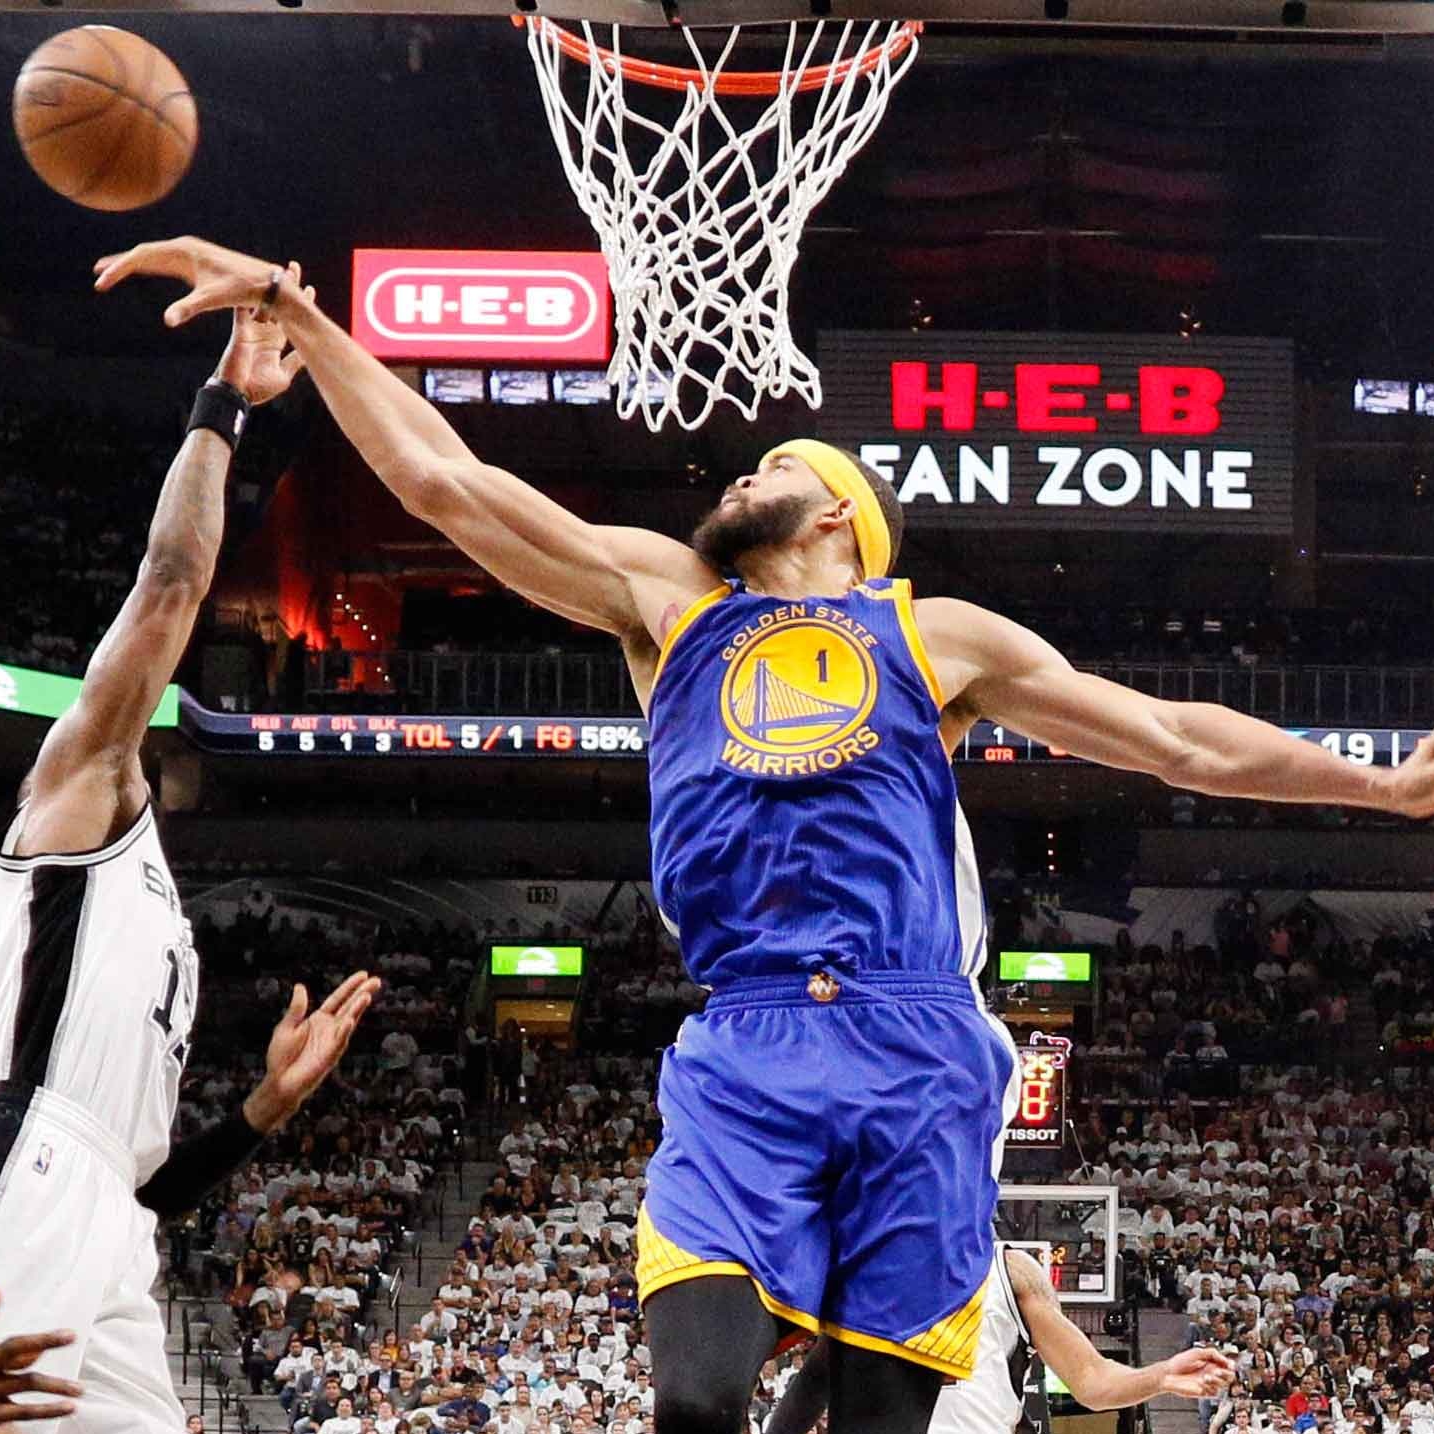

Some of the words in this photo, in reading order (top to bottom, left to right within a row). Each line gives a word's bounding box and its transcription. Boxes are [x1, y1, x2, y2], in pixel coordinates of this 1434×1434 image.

[393, 283, 576, 328] H-E-B
[890, 360, 1227, 436] H-E-B
[859, 443, 1011, 505] FAN
[1035, 446, 1254, 511] ZONE
[720, 603, 807, 662] GOLDEN
[814, 604, 879, 651] STATE
[816, 648, 829, 683] 1
[257, 731, 274, 752] 5
[298, 731, 316, 752] 5
[339, 732, 354, 752] 1
[375, 732, 392, 753] 3
[401, 723, 452, 750] TOL
[535, 725, 576, 750] FG
[719, 725, 881, 776] WARRIORS
[991, 726, 1005, 746] 1
[984, 746, 1014, 763] QTR
[1005, 1128, 1059, 1142] TISSOT
